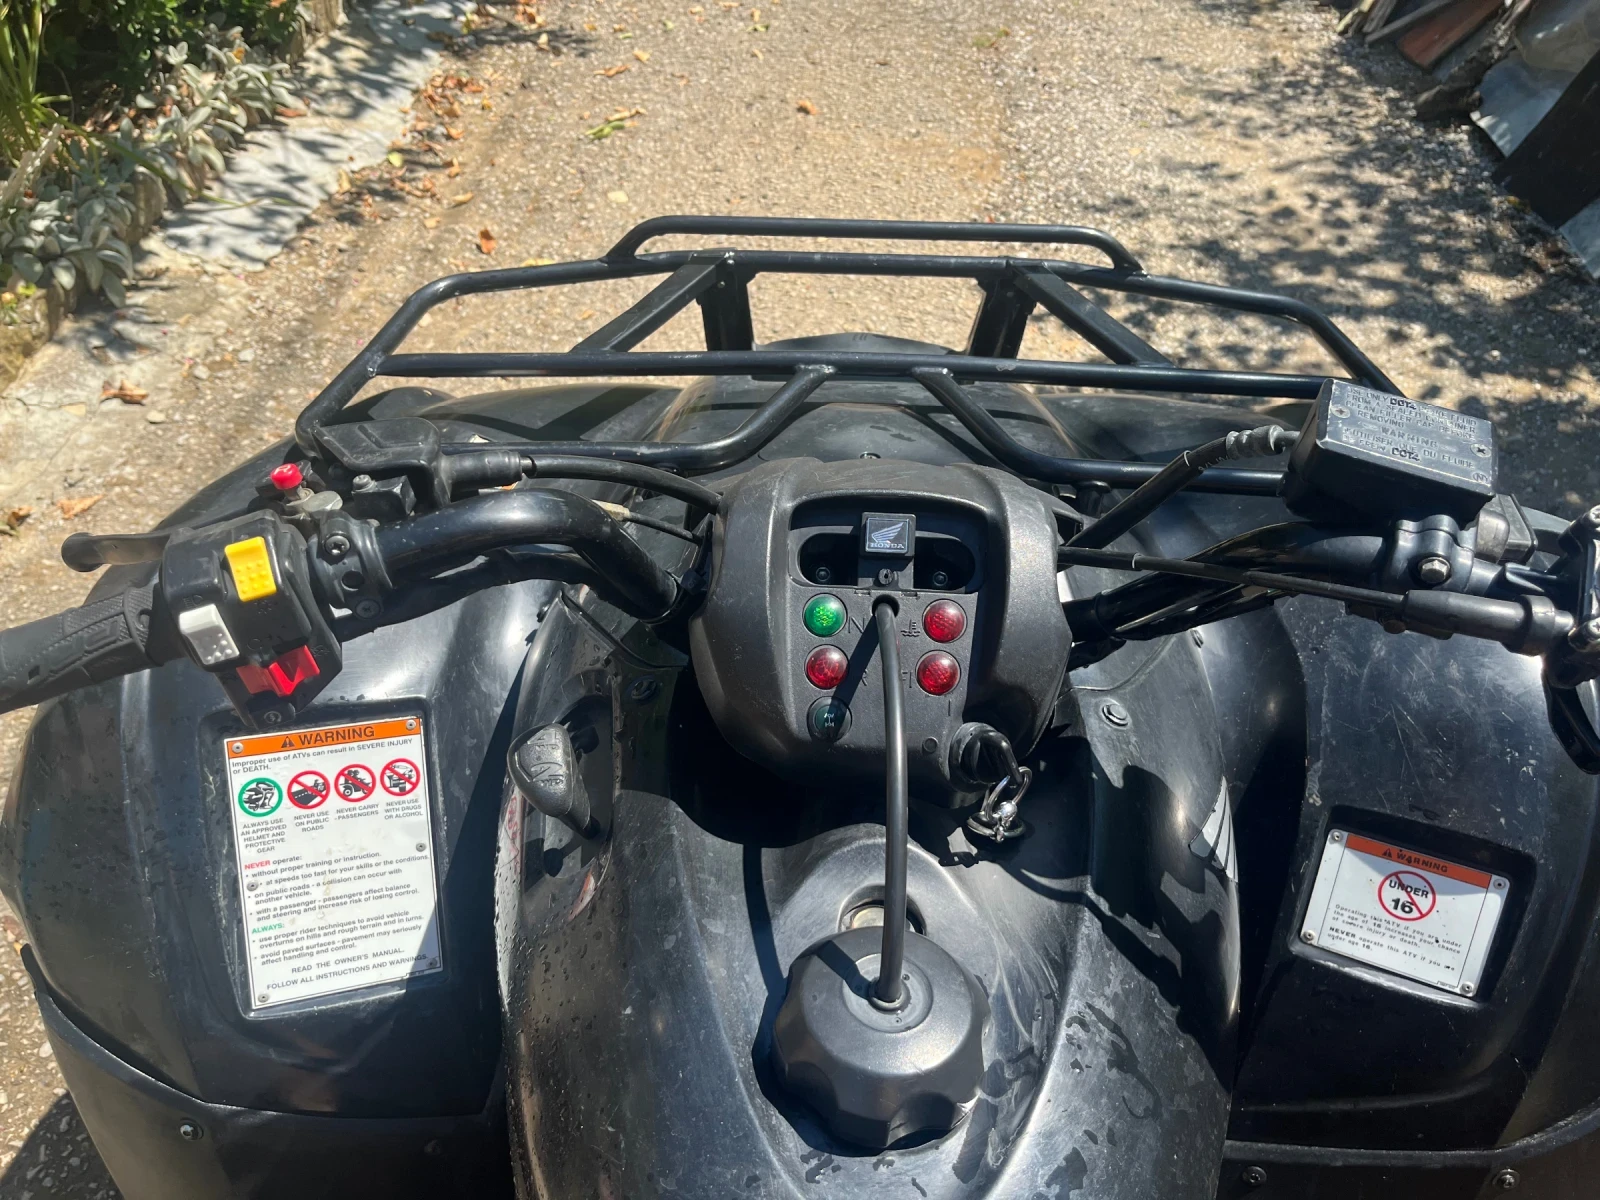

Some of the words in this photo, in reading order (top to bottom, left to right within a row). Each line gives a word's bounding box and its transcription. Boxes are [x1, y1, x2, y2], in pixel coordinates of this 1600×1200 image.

[298, 725, 374, 745] WARNING
[232, 759, 265, 767] Improper
[357, 742, 384, 750] SEVERE
[387, 738, 412, 746] INJURY
[243, 764, 270, 772] DEATH.
[242, 820, 268, 828] ALWAYS
[251, 824, 286, 833] APPROVED
[301, 824, 323, 832] ROADS
[243, 833, 269, 841] HELMET
[245, 837, 285, 848] PROTECTIVE
[244, 860, 270, 869] NEVER
[1396, 852, 1448, 872] WARNING
[252, 868, 278, 876] without
[280, 865, 303, 873] proper
[266, 888, 287, 896] public
[1389, 879, 1429, 898] UNDER
[255, 896, 282, 904] another
[279, 900, 316, 911] passenger
[323, 892, 362, 903] passengers
[364, 887, 383, 895] affect
[1391, 898, 1414, 914] 16
[272, 910, 301, 918] steering
[318, 902, 347, 910] increase
[251, 923, 284, 933] ALWAYS:
[274, 932, 297, 940] proper
[318, 921, 355, 931] techniques
[366, 914, 384, 922] avoid
[386, 910, 409, 918] vehicle
[1335, 904, 1366, 918] Operating
[1442, 939, 1461, 947] under
[260, 939, 293, 948] overturns
[338, 926, 357, 934] rough
[360, 922, 381, 930] terrain
[260, 950, 280, 958] avoid
[282, 946, 303, 955] paved
[305, 941, 335, 949] surfaces
[341, 932, 374, 944] pavement
[392, 924, 421, 933] seriously
[1327, 933, 1345, 941] under
[1329, 926, 1355, 938] NEVER
[1358, 937, 1383, 947] operate
[1402, 950, 1416, 958] ATV
[1366, 927, 1385, 937] injury
[1399, 937, 1419, 947] death.
[1384, 926, 1415, 939] increases
[1437, 944, 1460, 953] chance
[283, 952, 313, 960] handling
[291, 964, 312, 973] READ
[334, 954, 368, 964] OWNER'S
[372, 947, 404, 957] MANUAL.
[266, 979, 298, 989] FOLLOW
[315, 965, 369, 980] INSTRUCTIONS
[371, 961, 387, 969] AND
